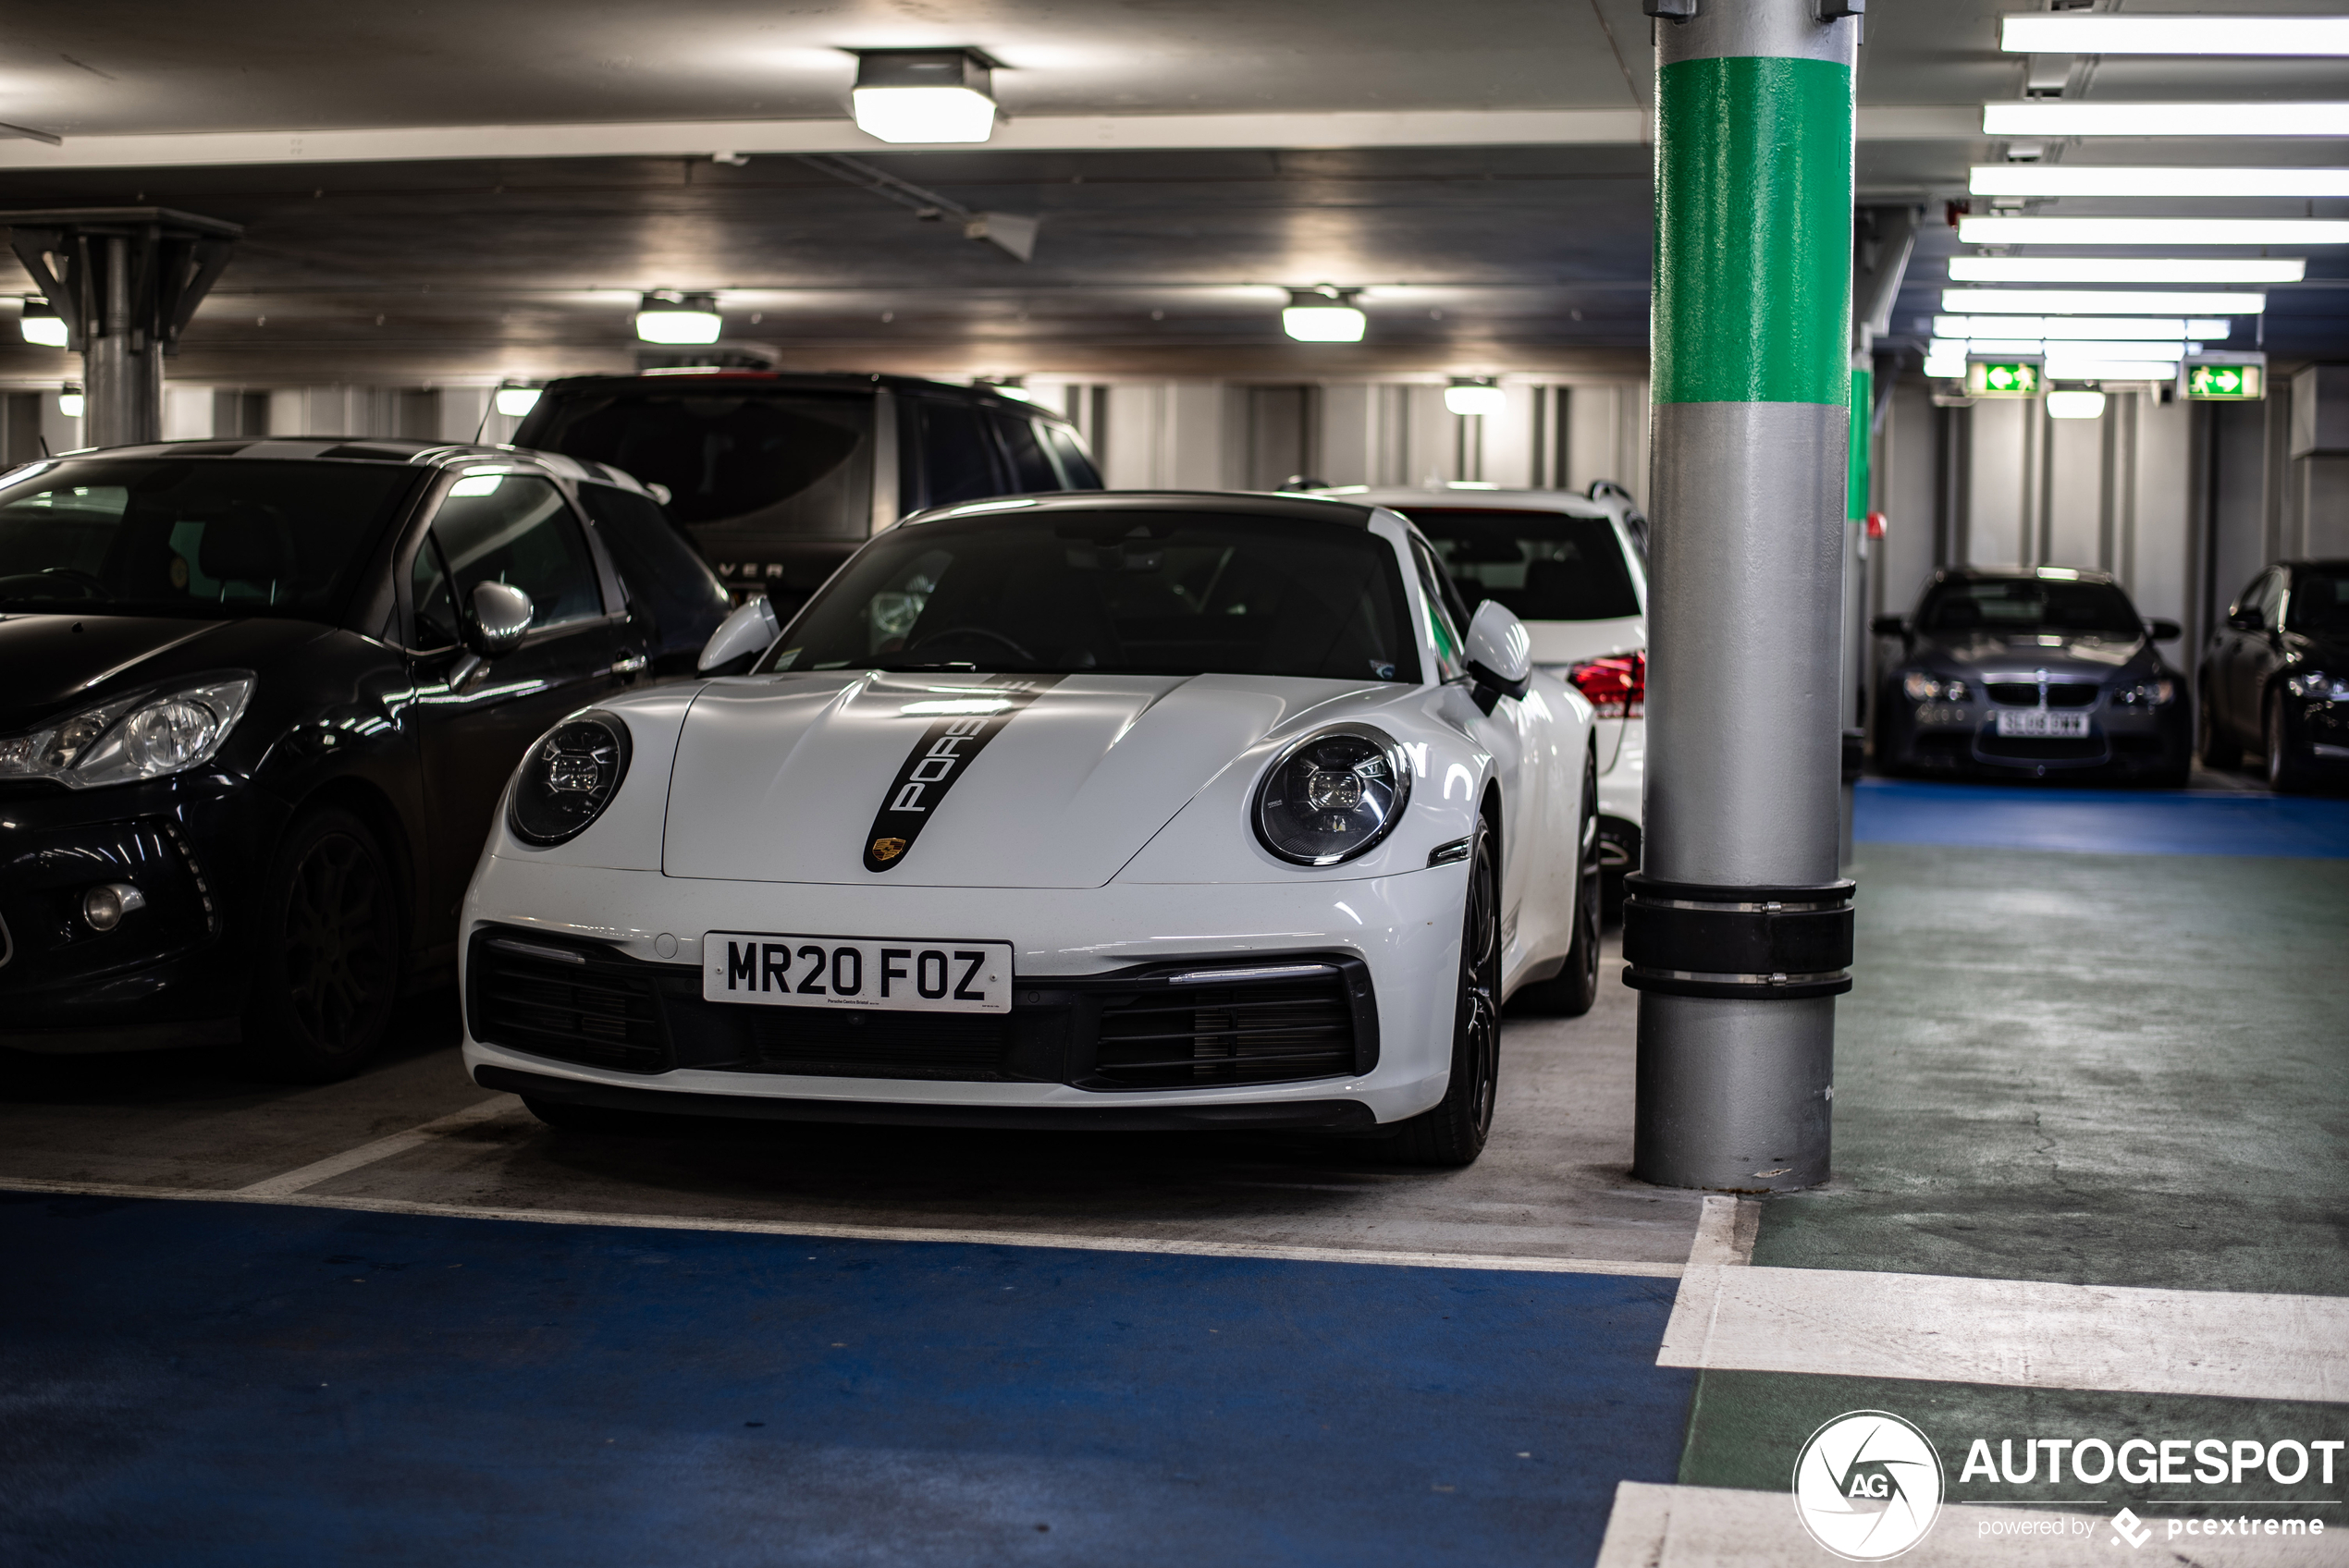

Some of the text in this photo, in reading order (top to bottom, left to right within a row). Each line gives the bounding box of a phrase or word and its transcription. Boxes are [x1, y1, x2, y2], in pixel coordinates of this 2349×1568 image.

[890, 681, 1036, 812] PORSE
[728, 940, 987, 1001] MR20 FOZ
